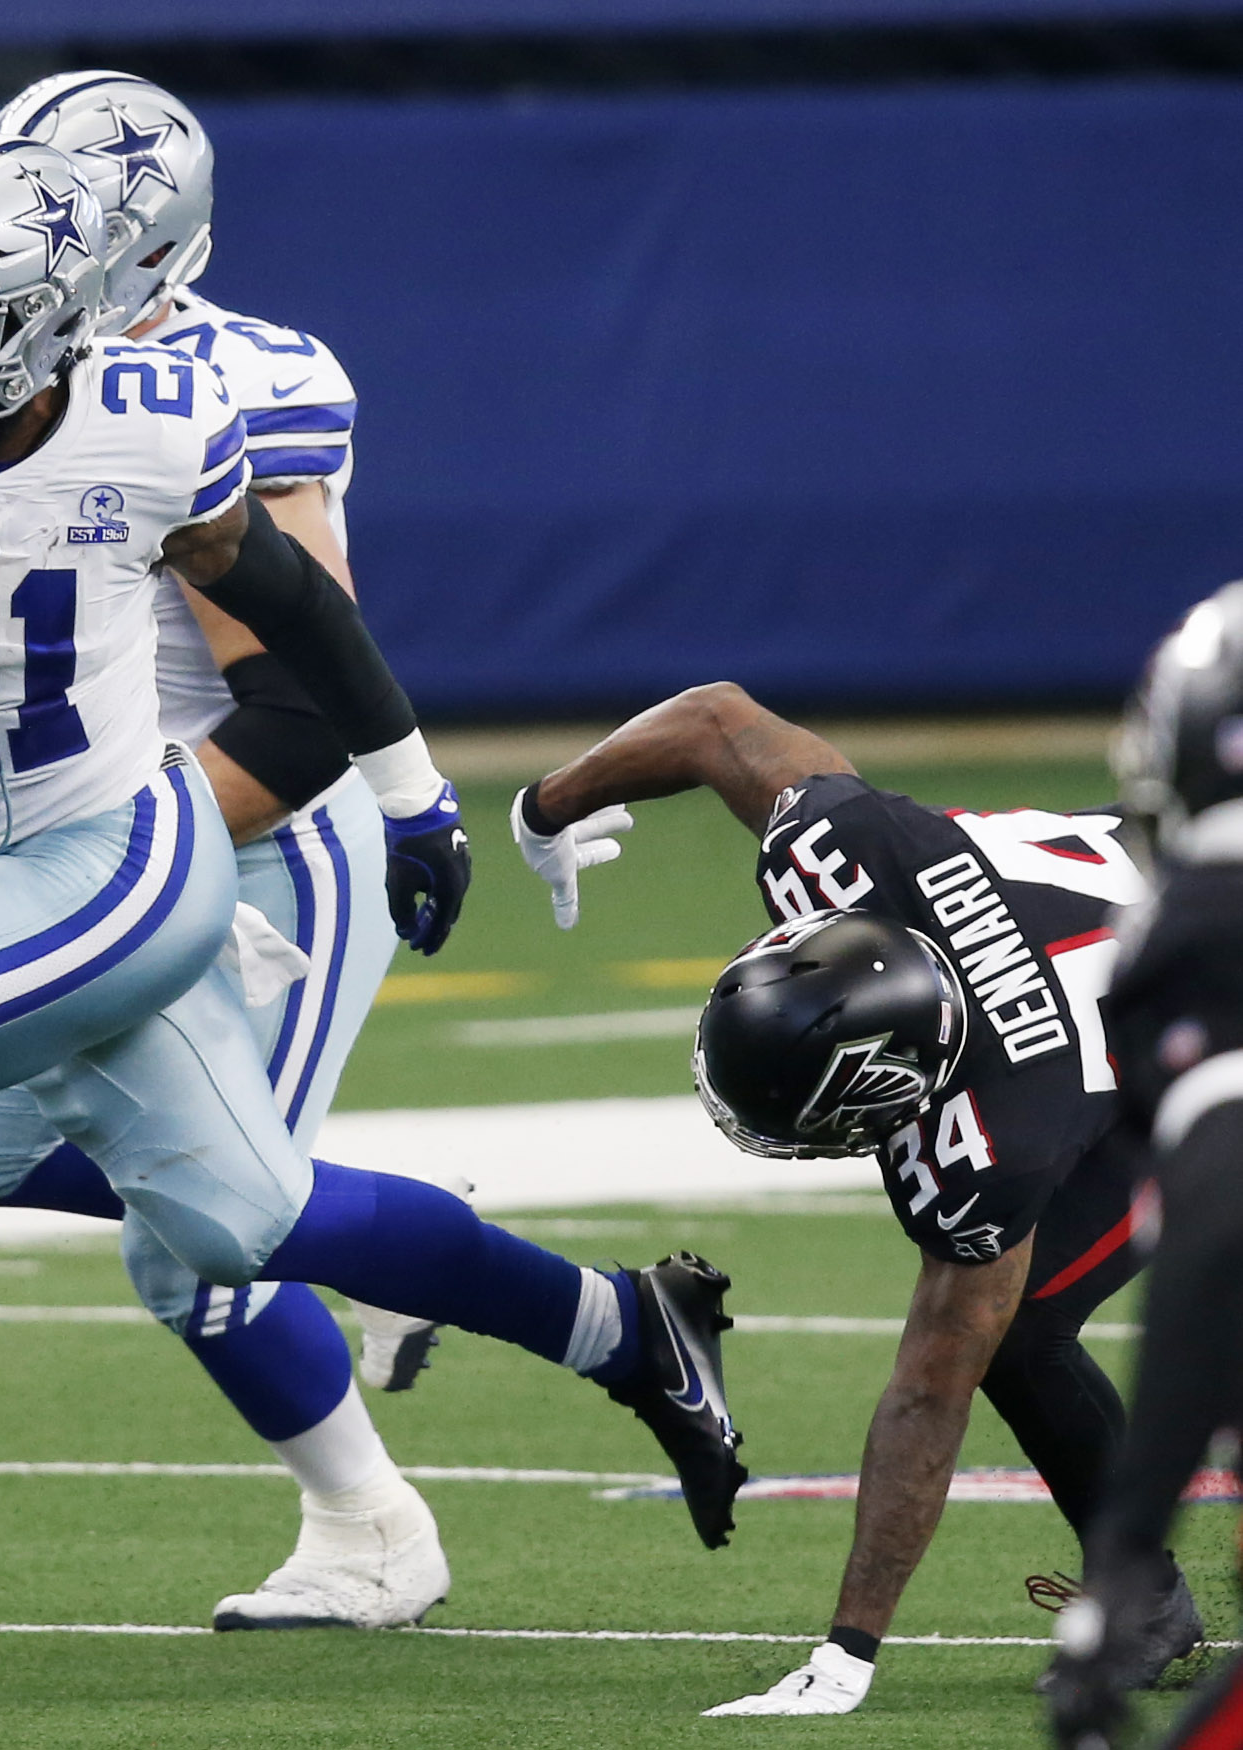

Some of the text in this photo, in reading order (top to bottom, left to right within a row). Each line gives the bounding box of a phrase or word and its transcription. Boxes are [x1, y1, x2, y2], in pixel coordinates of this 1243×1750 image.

[101, 345, 194, 419] 21
[69, 528, 127, 542] EST. 1960
[915, 852, 1070, 1064] DENNARD
[887, 1089, 997, 1216] 34
